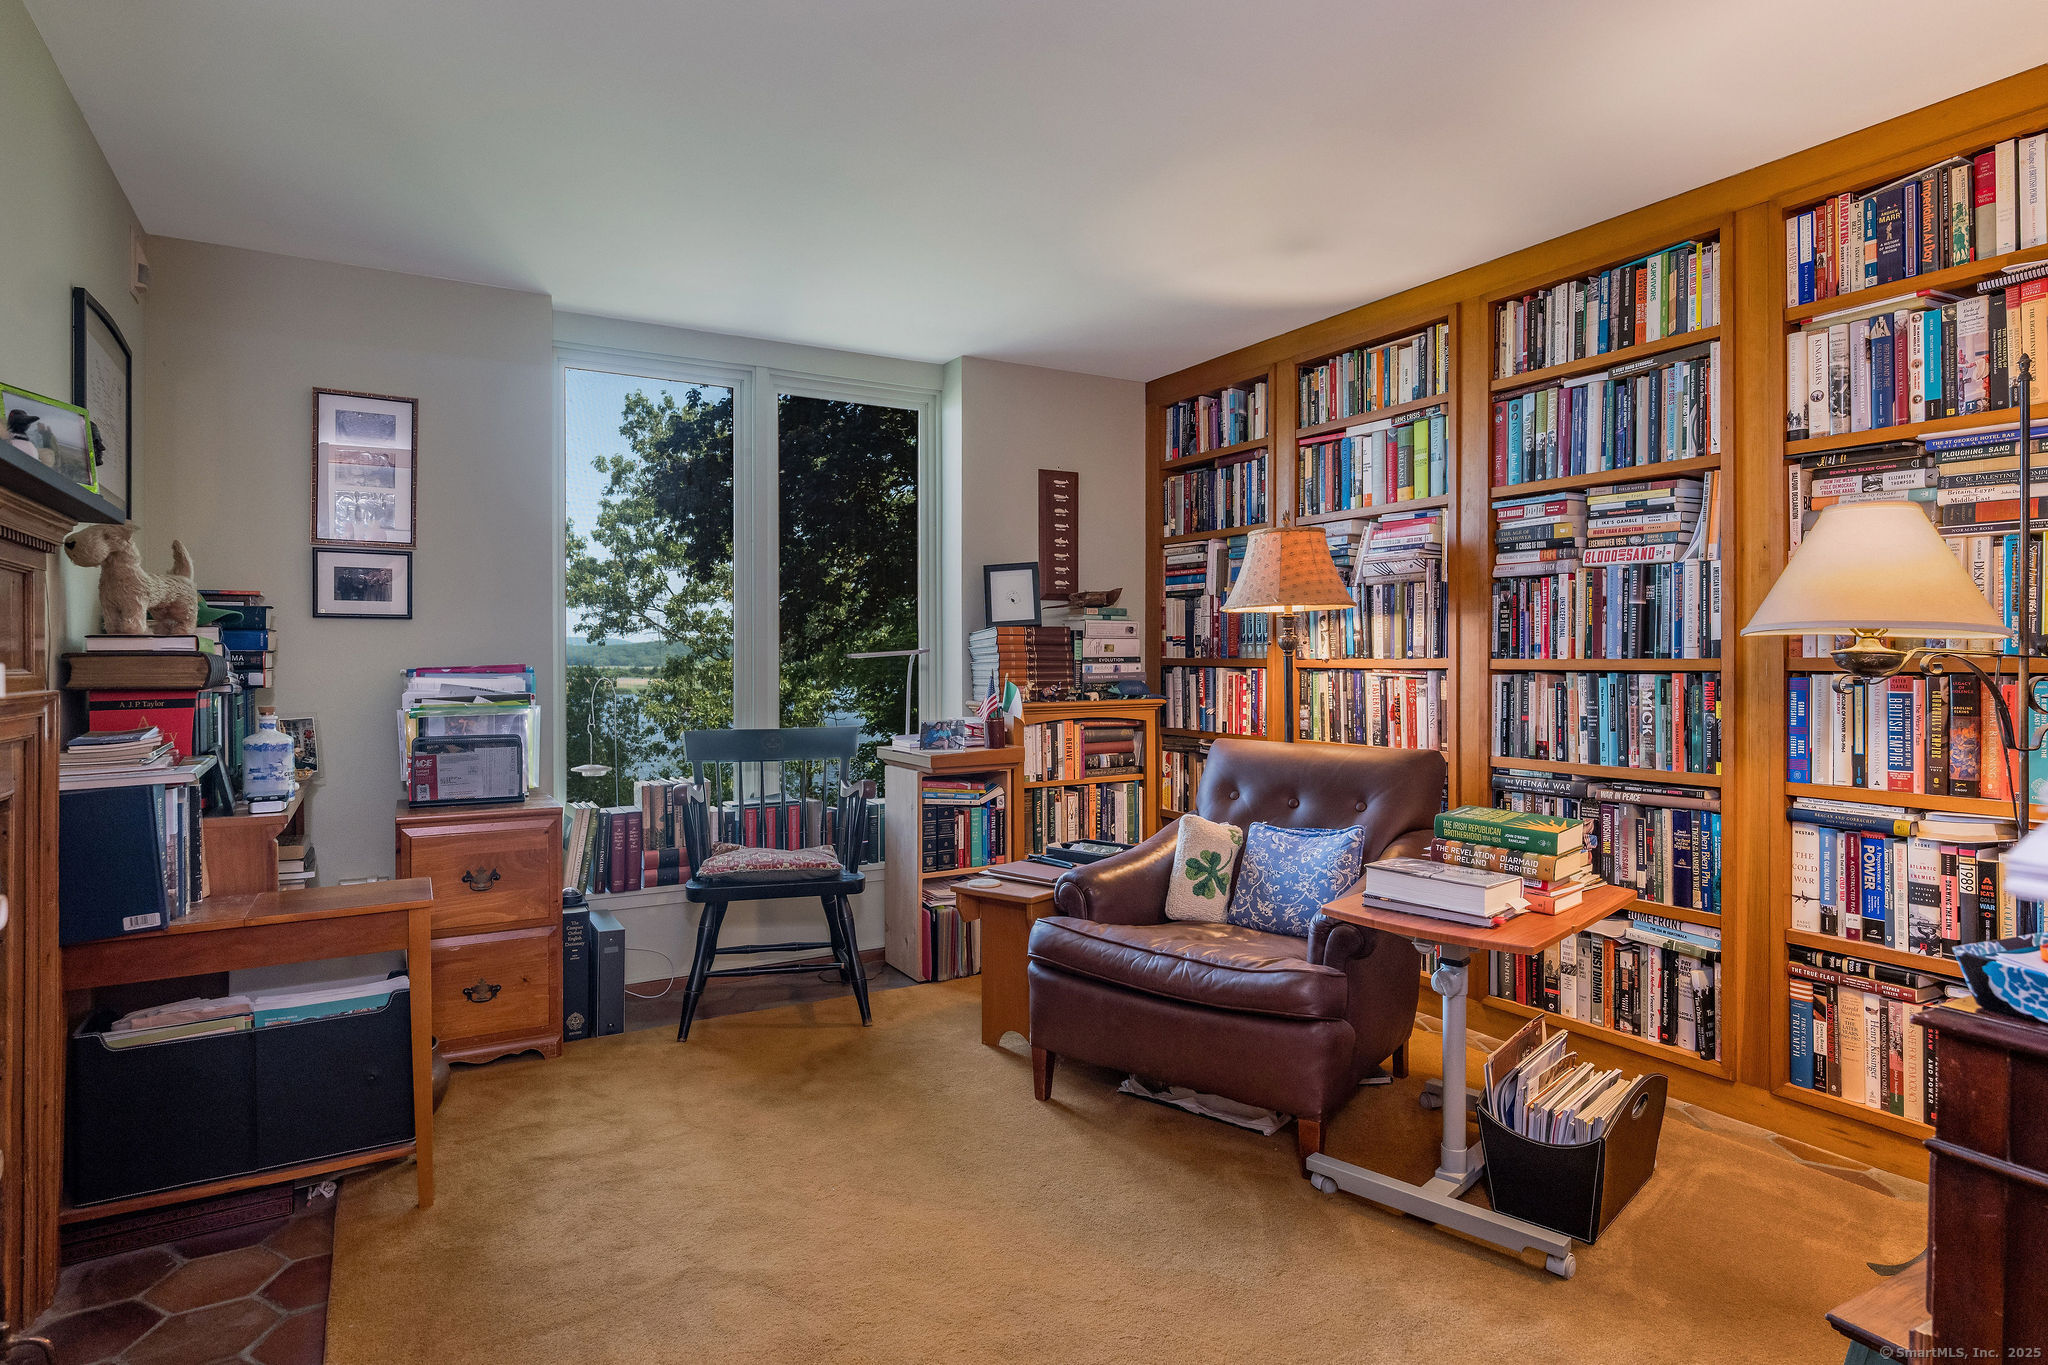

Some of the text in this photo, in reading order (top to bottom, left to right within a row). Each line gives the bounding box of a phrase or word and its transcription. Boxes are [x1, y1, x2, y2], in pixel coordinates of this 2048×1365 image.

[1840, 194, 1849, 245] WARPATHS
[1878, 213, 1901, 224] MARR
[1921, 180, 1935, 263] Imperialism At Day
[1575, 291, 1584, 312] WOUNDS
[1942, 445, 2010, 458] PLOUGHING SAND
[1976, 472, 2019, 480] PALESTINE,
[1588, 537, 1627, 548] EISENHOWER 1956
[1584, 549, 1617, 563] BLOOD
[1626, 547, 1655, 561] SAND
[1407, 683, 1415, 703] 1916
[1704, 682, 1715, 711] PROVOS
[1642, 691, 1654, 735] MICK
[1932, 690, 1941, 758] CHURCHILL'S EMPIRE
[1889, 698, 1903, 766] BRITISH EMPIRE
[416, 759, 432, 768] ACE
[1515, 780, 1549, 788] VIETNAM
[1553, 782, 1571, 791] WAR
[1600, 791, 1613, 799] WAR
[1622, 793, 1641, 801] PEACE
[1443, 820, 1501, 836] THE IRISH REPUBLICAN
[1444, 829, 1481, 841] BROTHERHOOD
[1603, 813, 1611, 854] CHOOSING WAR
[1436, 844, 1496, 860] THE REVELATION
[1701, 831, 1710, 887] Dien Bien Phu
[1794, 852, 1815, 861] THE
[1454, 856, 1486, 866] IRELAND
[1500, 856, 1538, 867] DIARMAID
[1792, 862, 1818, 873] COLD
[1864, 845, 1875, 890] POWER
[1499, 864, 1537, 875] FERRITER
[1794, 875, 1815, 885] WAR
[1960, 867, 1974, 892] 1989
[1980, 903, 1995, 911] WAR
[1593, 946, 1602, 1003] FIRST DOMINO
[1820, 973, 1835, 981] FLAG
[1792, 1013, 1800, 1057] TRIUMPH
[1870, 1020, 1878, 1079] Henry Kissinger
